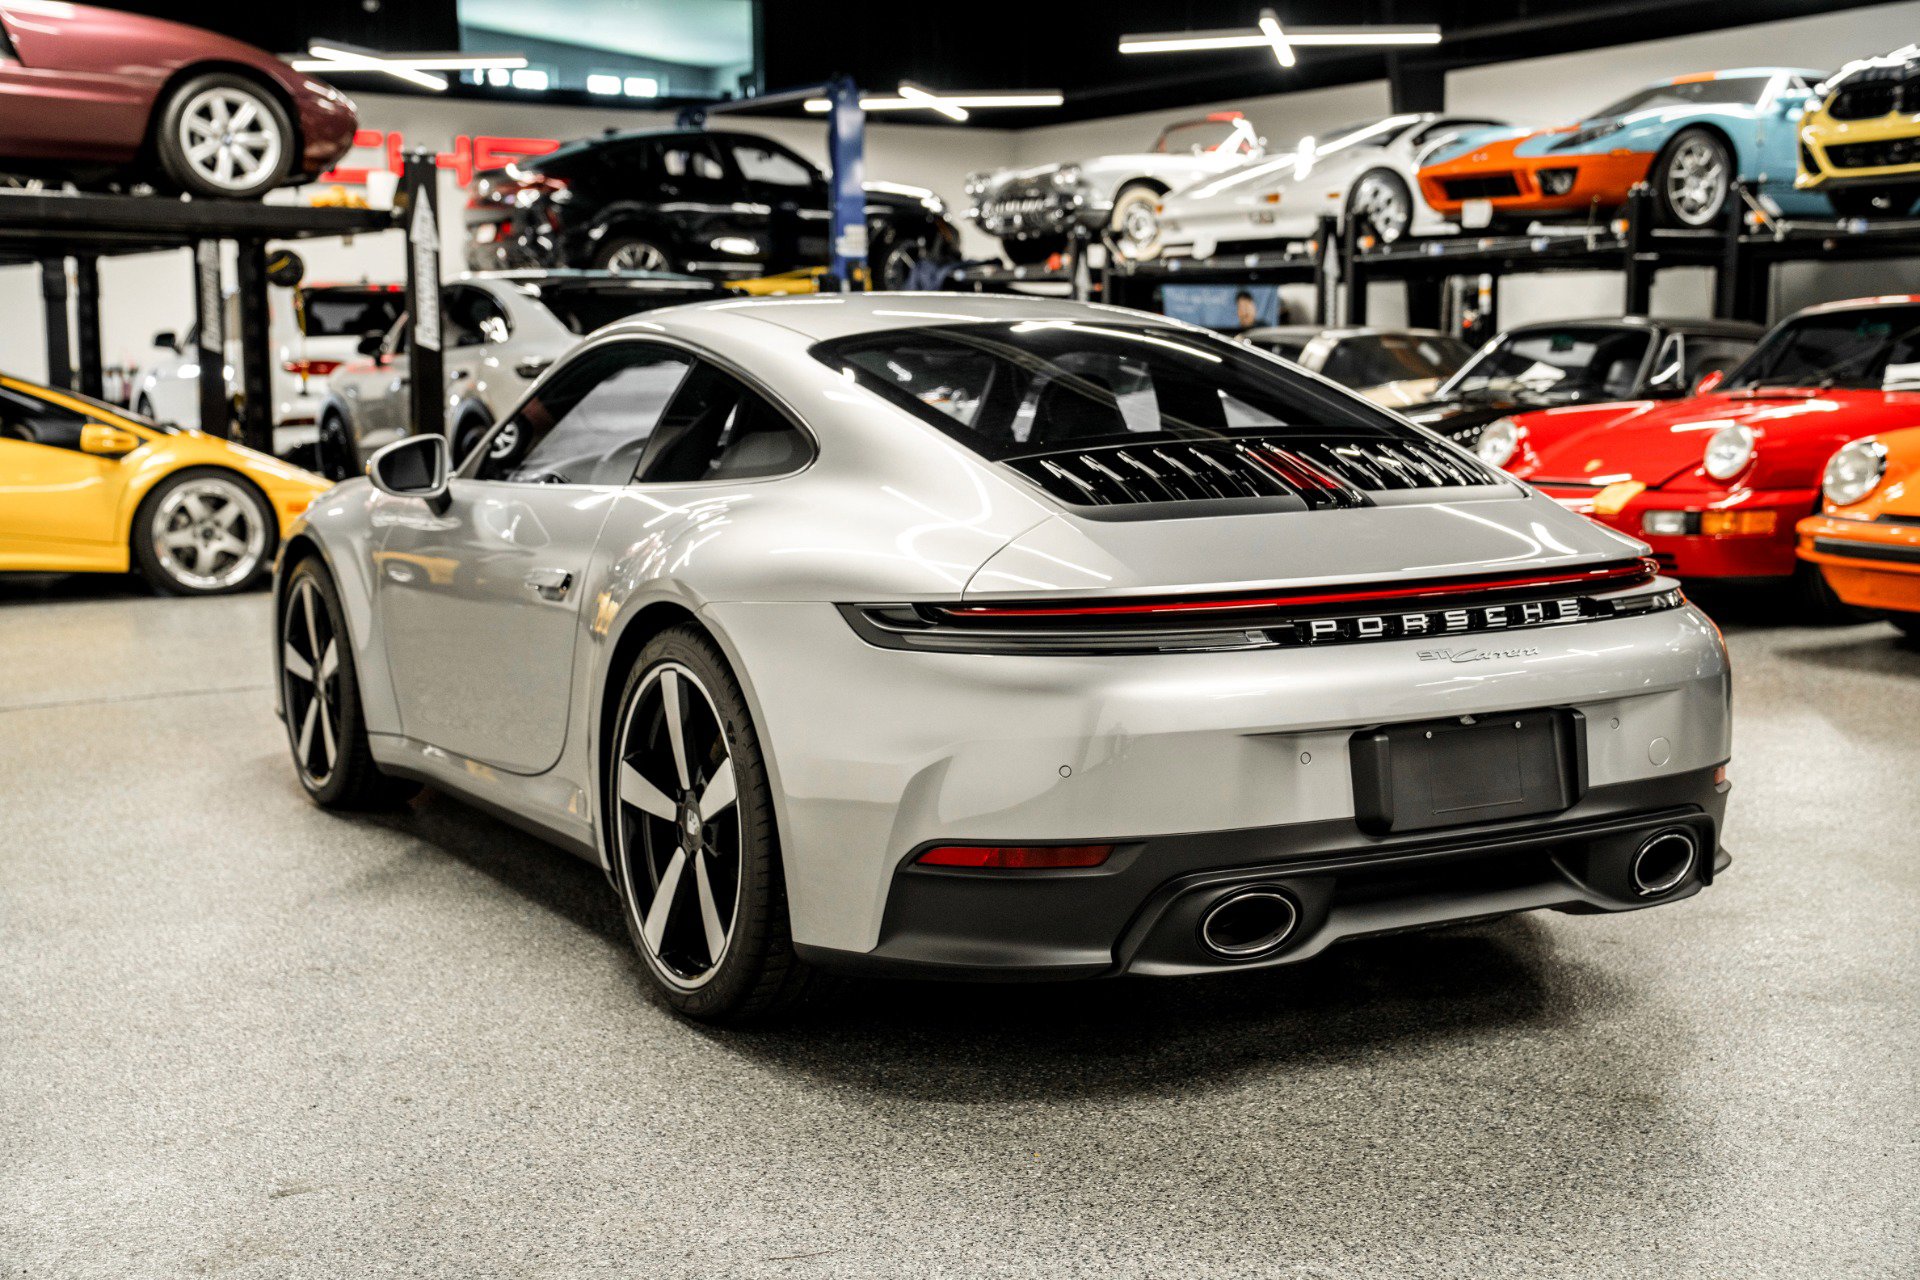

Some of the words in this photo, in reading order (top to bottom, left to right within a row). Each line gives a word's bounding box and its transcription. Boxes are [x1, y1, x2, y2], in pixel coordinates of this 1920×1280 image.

[1310, 599, 1578, 639] PORSCHE
[1416, 648, 1453, 661] 911
[1450, 646, 1539, 663] Carrera
